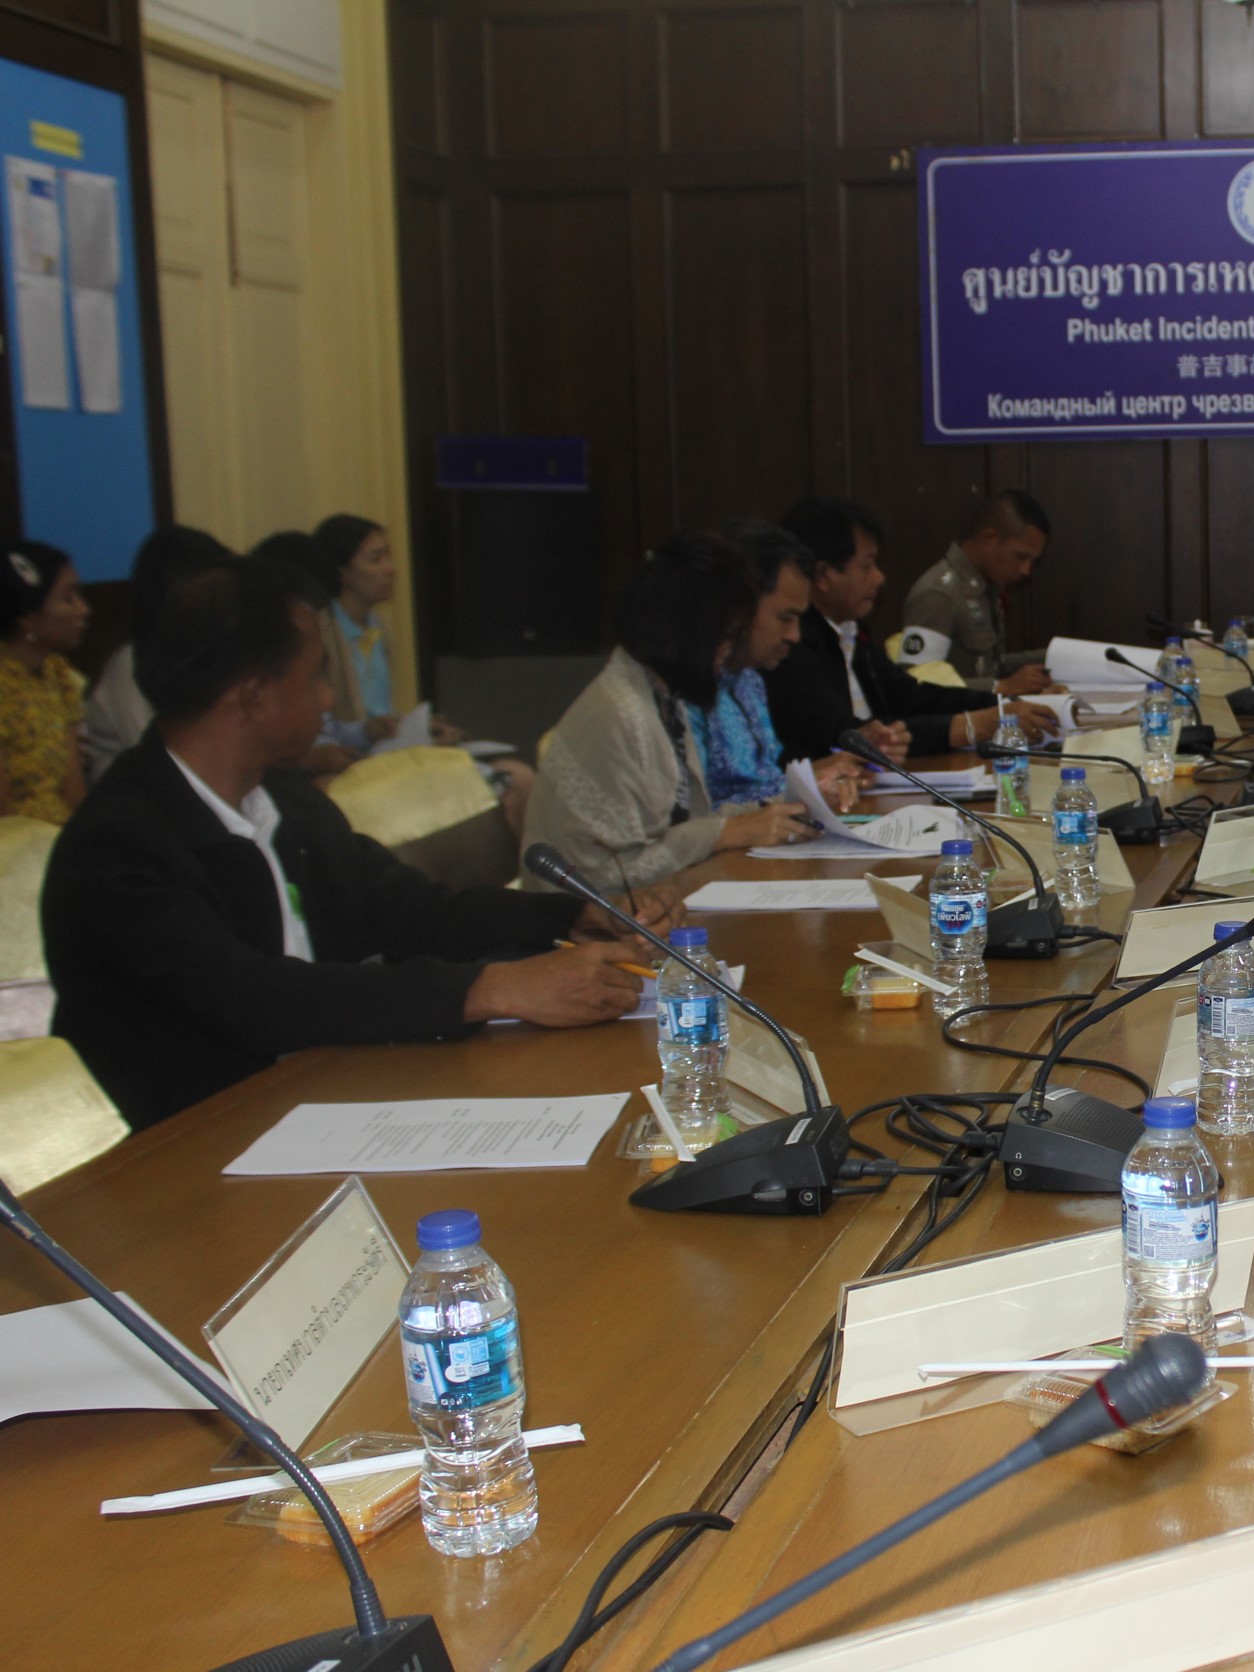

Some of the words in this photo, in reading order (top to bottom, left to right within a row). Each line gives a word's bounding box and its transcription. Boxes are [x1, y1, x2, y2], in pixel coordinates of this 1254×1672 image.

[1067, 317, 1153, 343] Phuket
[987, 391, 1117, 420] Командный
[1122, 394, 1187, 420] центр
